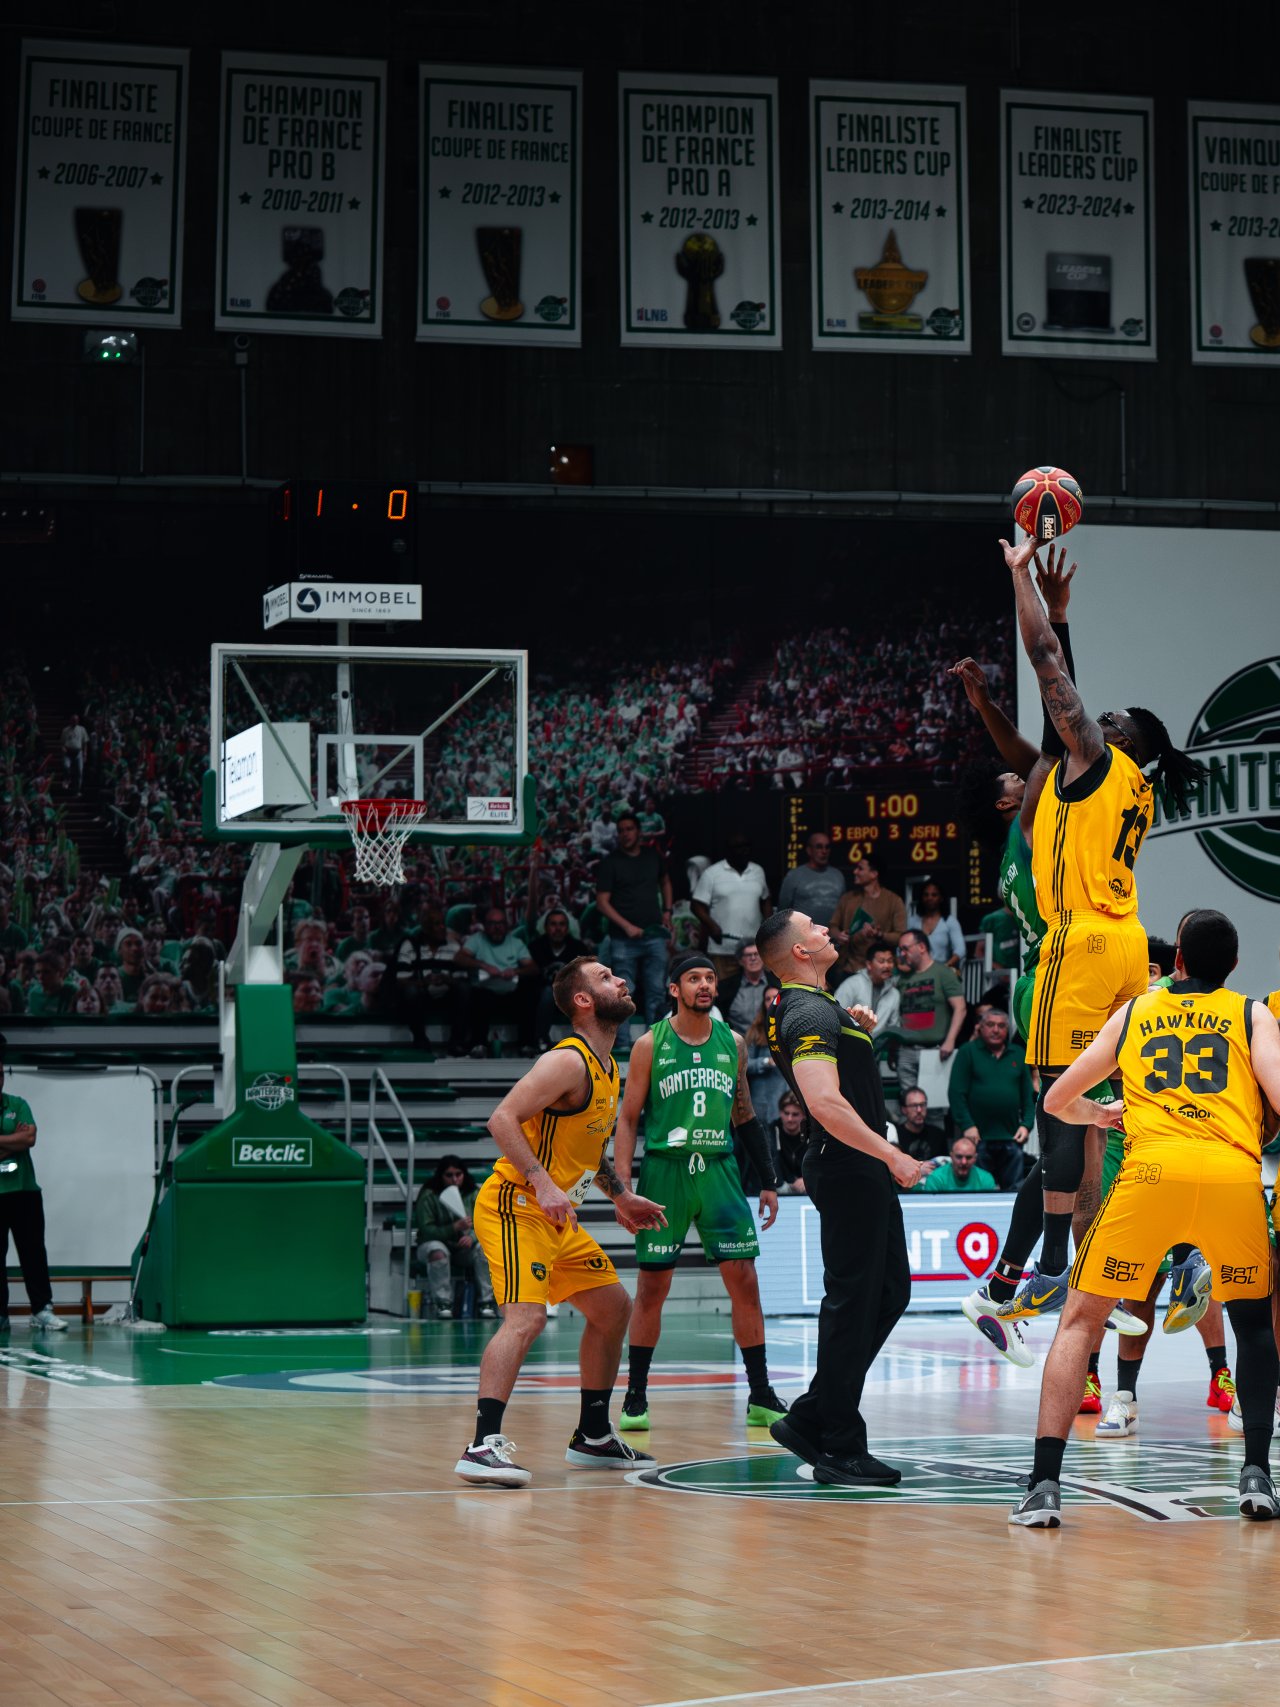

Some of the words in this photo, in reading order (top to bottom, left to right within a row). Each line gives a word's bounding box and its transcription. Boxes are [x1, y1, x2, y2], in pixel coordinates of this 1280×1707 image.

[50, 79, 157, 113] FINALISTE
[245, 84, 362, 119] CHAMPION
[449, 101, 553, 133] FINALISTE
[642, 105, 753, 134] CHAMPION
[838, 113, 940, 144] FINALISTE
[32, 116, 86, 139] COUPE
[90, 118, 109, 140] DE
[113, 120, 172, 143] FRANCE
[244, 117, 269, 146] DE
[278, 120, 362, 150] FRANCE
[1034, 126, 1122, 154] FINALISTE
[432, 137, 481, 158] COUPE
[488, 140, 506, 159] DE
[511, 140, 568, 163] FRANCE
[642, 136, 667, 163] DE
[676, 138, 754, 166] FRANCE
[269, 150, 312, 180] PRO
[321, 153, 335, 181] B
[827, 148, 907, 174] LEADERS
[914, 151, 950, 177] CUP
[1019, 150, 1096, 179] LEADERS
[1101, 156, 1138, 182] CUP
[54, 164, 148, 188] 2006-2007
[668, 169, 710, 196] PRO
[718, 171, 731, 197] A
[1201, 172, 1248, 192] COUPE
[1253, 174, 1268, 194] DE
[262, 189, 343, 213] 2010-2011
[462, 184, 545, 207] 2012-2013
[1037, 194, 1121, 218] 2023-2024
[660, 207, 739, 230] 2012-2013
[851, 199, 929, 221] 2013-2014
[1055, 264, 1103, 275] LEADERS
[645, 308, 667, 322] LNB
[326, 590, 417, 605] IMMOBEL
[866, 794, 918, 818] 1:00
[832, 826, 842, 841] 3
[890, 824, 900, 839] 3
[910, 825, 940, 839] JSFN
[946, 823, 957, 838] 2
[911, 842, 938, 862] 65
[1087, 934, 1106, 954] 13
[1140, 1012, 1232, 1037] HAWKINS
[1140, 1032, 1229, 1094] 33
[693, 1091, 706, 1117] 8
[692, 1129, 725, 1139] GTM
[239, 1143, 306, 1162] Betclic
[1135, 1163, 1162, 1185] 33
[1102, 1267, 1139, 1282] SOL
[1221, 1273, 1256, 1285] SOL
